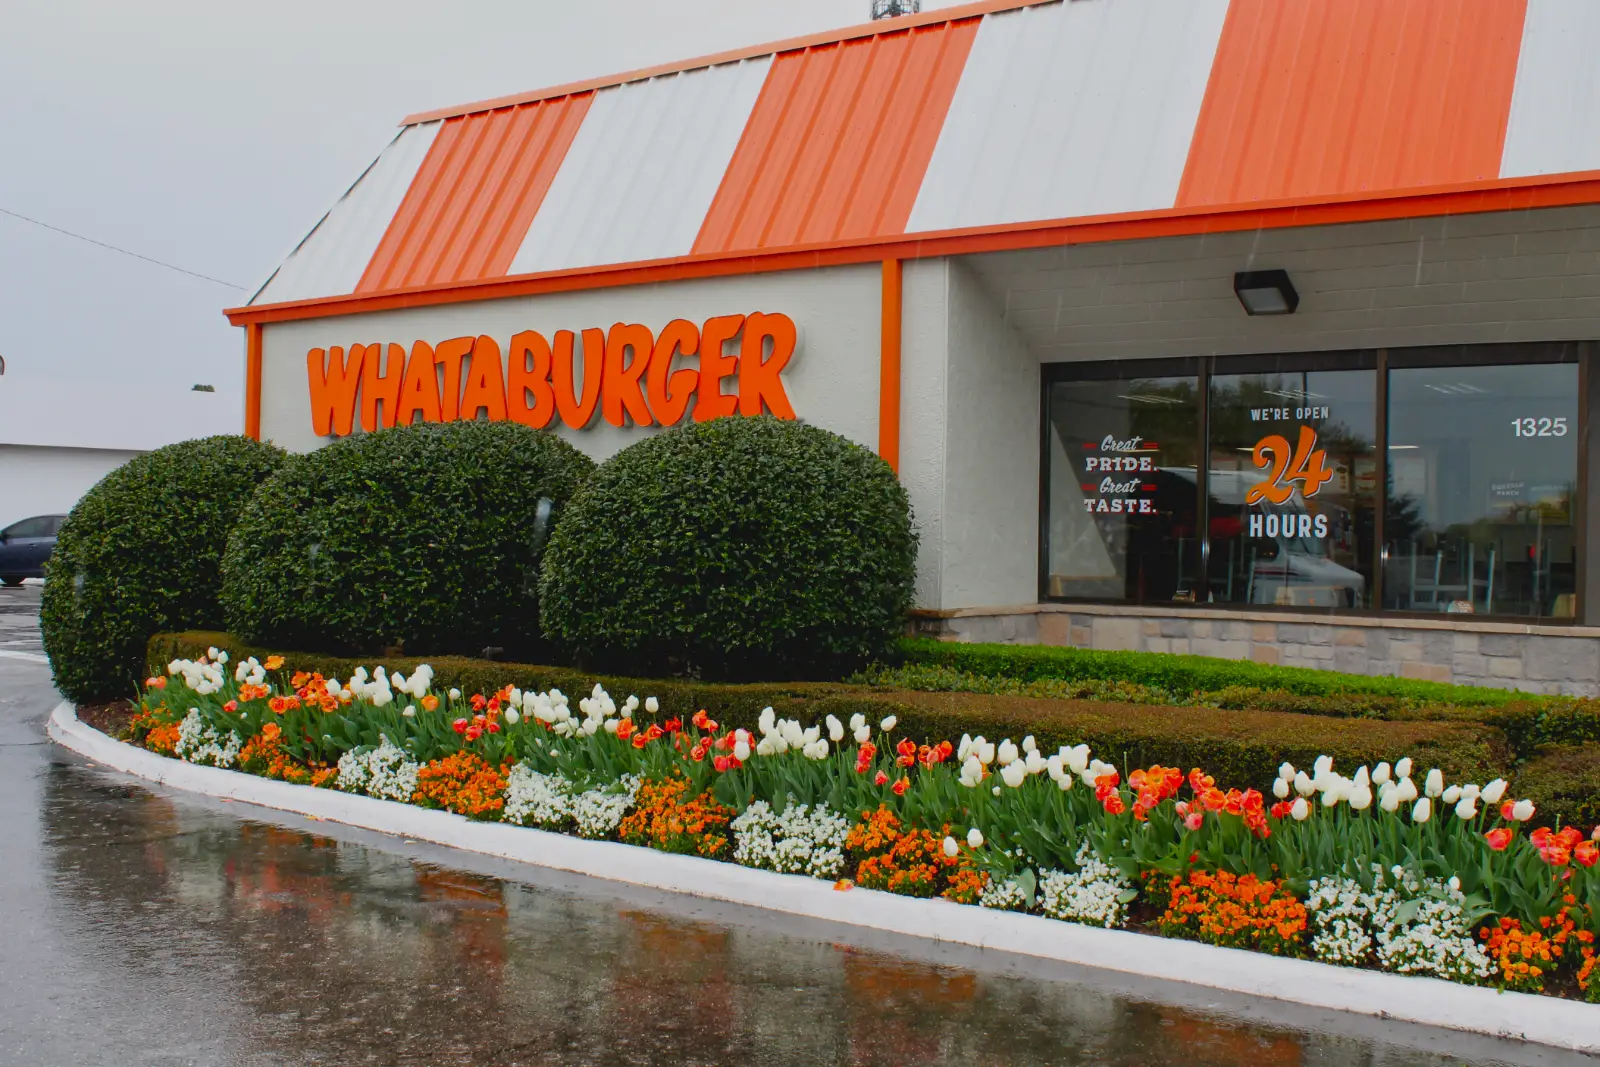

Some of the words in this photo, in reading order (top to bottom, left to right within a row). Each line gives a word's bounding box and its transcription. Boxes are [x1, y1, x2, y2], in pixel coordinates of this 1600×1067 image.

[307, 311, 797, 437] WHATABURGER
[1251, 407, 1289, 421] WE'RE
[1296, 406, 1329, 419] OPEN
[1511, 417, 1567, 437] 1325
[1101, 434, 1143, 452] Great
[1085, 457, 1158, 472] PRIDE.
[1245, 425, 1333, 506] 24
[1100, 476, 1142, 493] Great
[1084, 498, 1157, 513] TASTE.
[1249, 513, 1328, 538] HOURS
